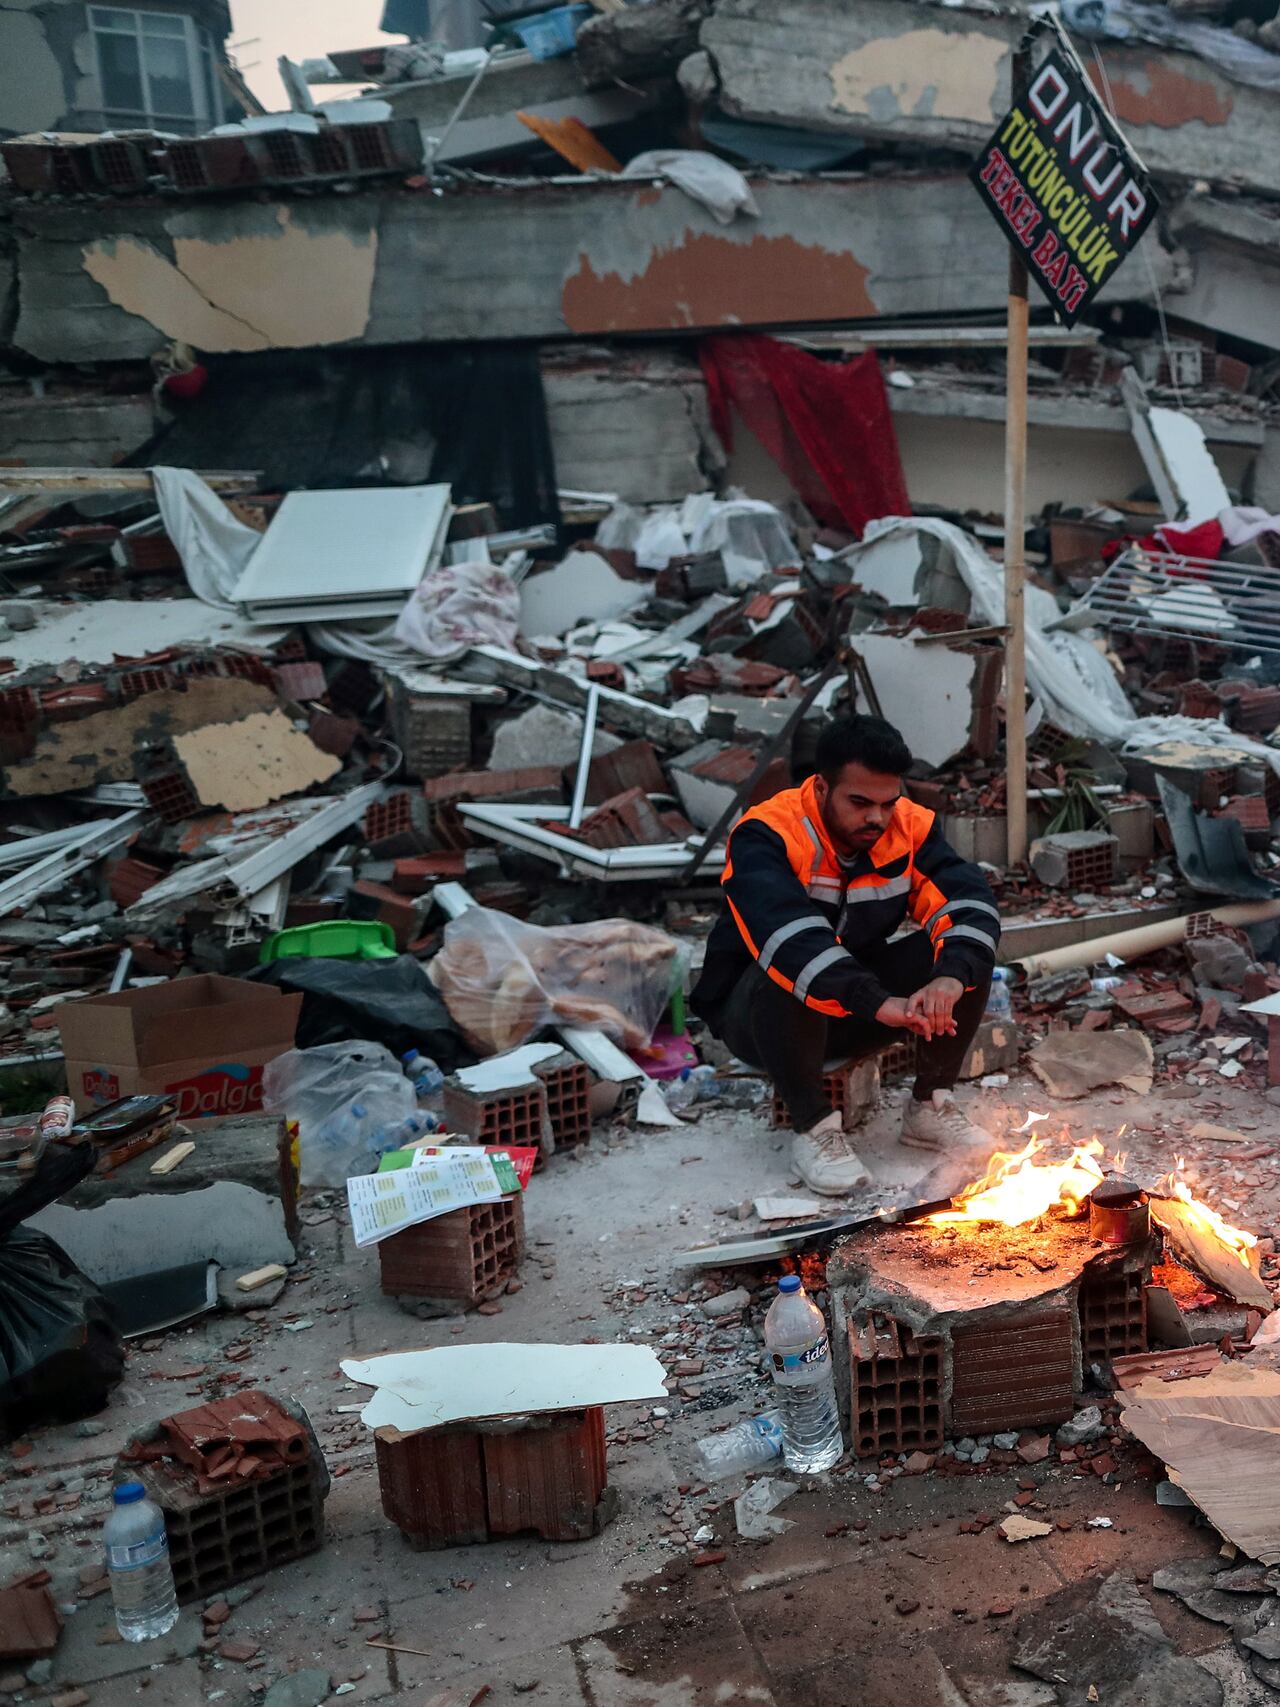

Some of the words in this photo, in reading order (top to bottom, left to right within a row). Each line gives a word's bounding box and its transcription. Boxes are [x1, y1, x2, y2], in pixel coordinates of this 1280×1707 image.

[979, 147, 1042, 248] TEKEL
[1000, 107, 1118, 283] TÜTÜNCÜLÜK
[1028, 64, 1147, 243] ONUR
